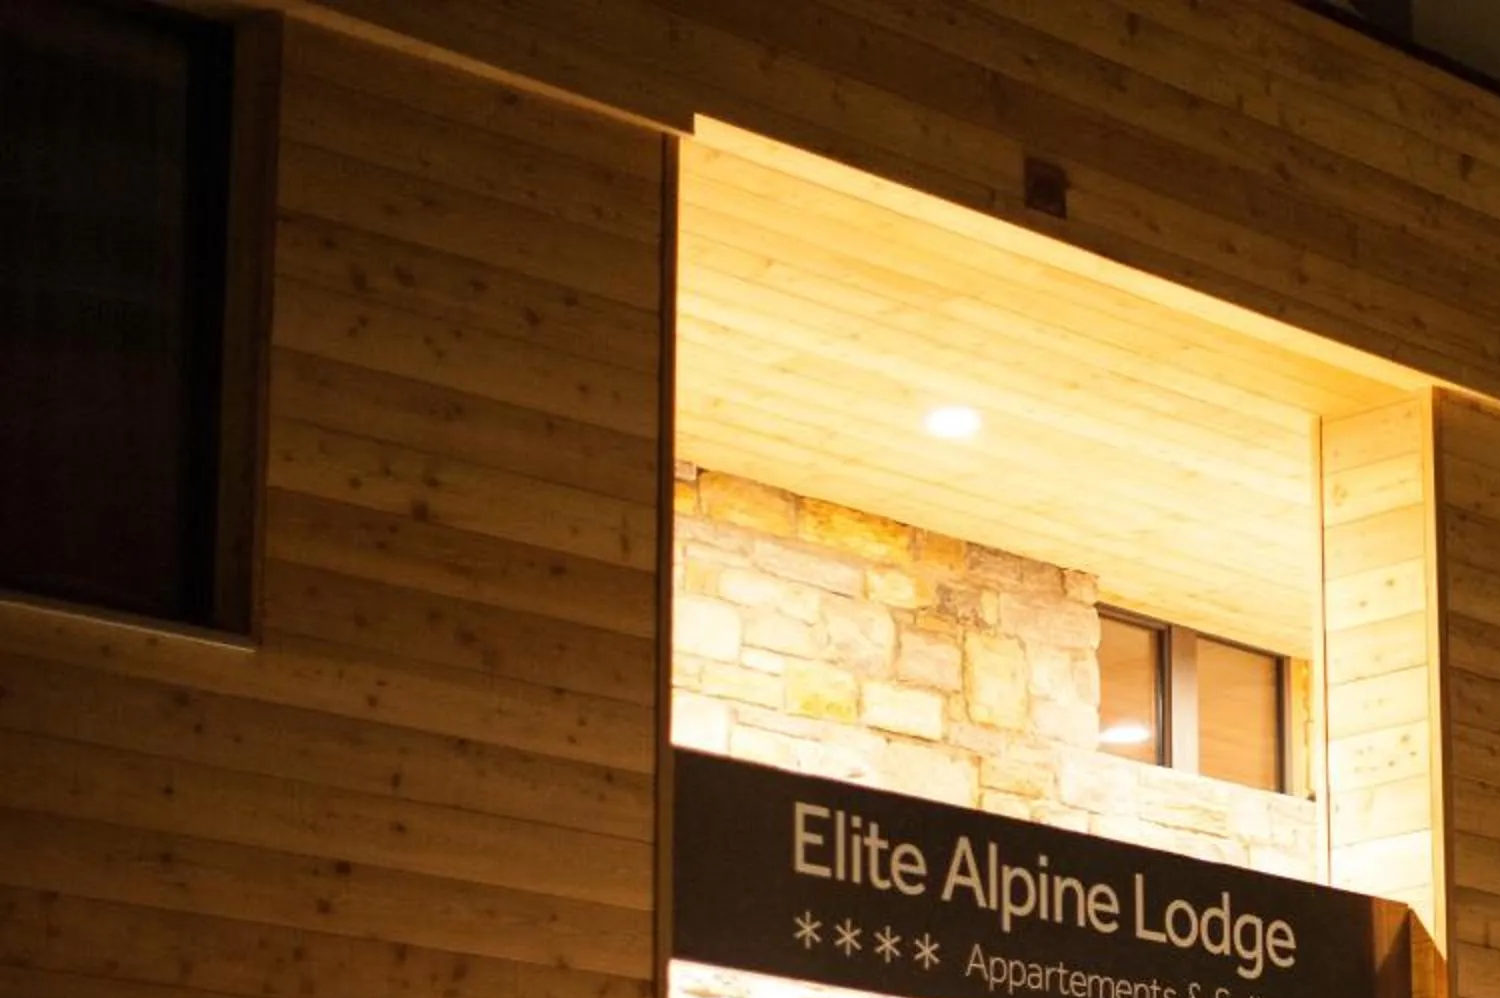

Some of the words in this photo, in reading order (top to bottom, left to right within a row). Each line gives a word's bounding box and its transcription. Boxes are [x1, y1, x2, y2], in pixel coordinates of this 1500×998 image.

[793, 801, 928, 896] Elite
[941, 836, 1120, 934] Alpine
[1133, 873, 1298, 979] Lodge
